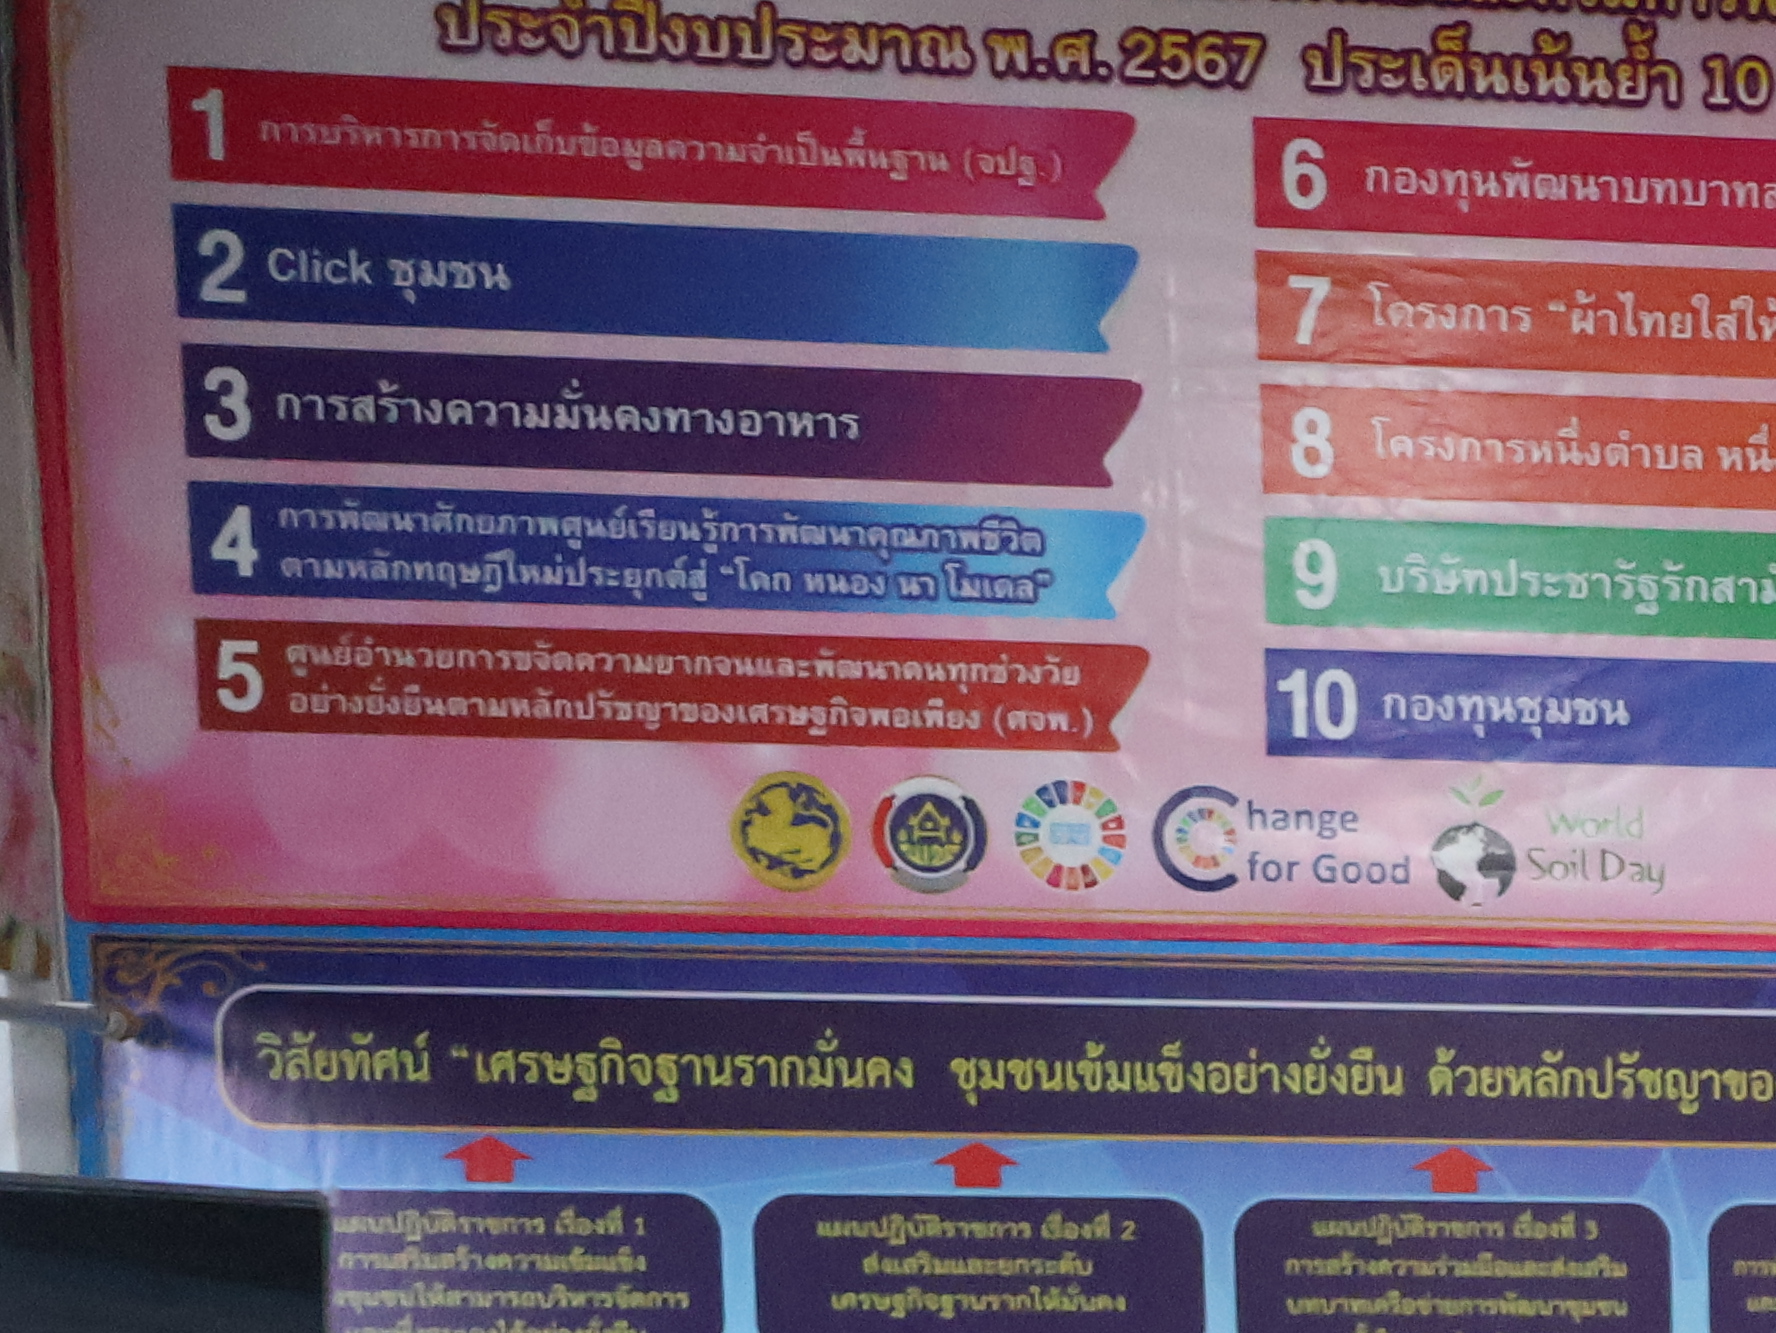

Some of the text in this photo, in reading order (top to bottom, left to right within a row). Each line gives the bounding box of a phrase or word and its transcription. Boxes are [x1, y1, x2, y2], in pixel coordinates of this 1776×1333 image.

[1123, 32, 1265, 86] 2567
[1301, 31, 1680, 105] ประเด็นเน้นย้ำ
[1704, 63, 1771, 112] 10
[190, 89, 227, 161] 1
[259, 112, 949, 180] การบริหารการจัดเก็บข้อมูลความจำเป็นพื้นฐาน
[1281, 139, 1327, 211] 6
[198, 232, 511, 303] 2 Click ชุมชน
[1288, 275, 1332, 345] 7
[1366, 282, 1533, 335] โครงการ
[202, 367, 860, 446] 3 การสร้างความมั่นคงทางอาหาร
[1290, 406, 1334, 478] 8
[1372, 417, 1704, 472] โครงการหนึ่งตำบล
[212, 507, 257, 577] 4
[1293, 538, 1338, 610] 9
[804, 568, 886, 599] หนอง
[897, 571, 936, 599] นา
[216, 641, 263, 711] 5
[1277, 669, 1629, 741] 10 กองทุนชุมชน
[1545, 806, 1647, 840] World
[1247, 852, 1411, 888] for Good
[1527, 849, 1666, 896] Soil Day
[256, 1031, 431, 1085] วิสัยทัศน์
[950, 1036, 1404, 1108] ชุมชนเข้มแข็งอย่างยั่งยืน
